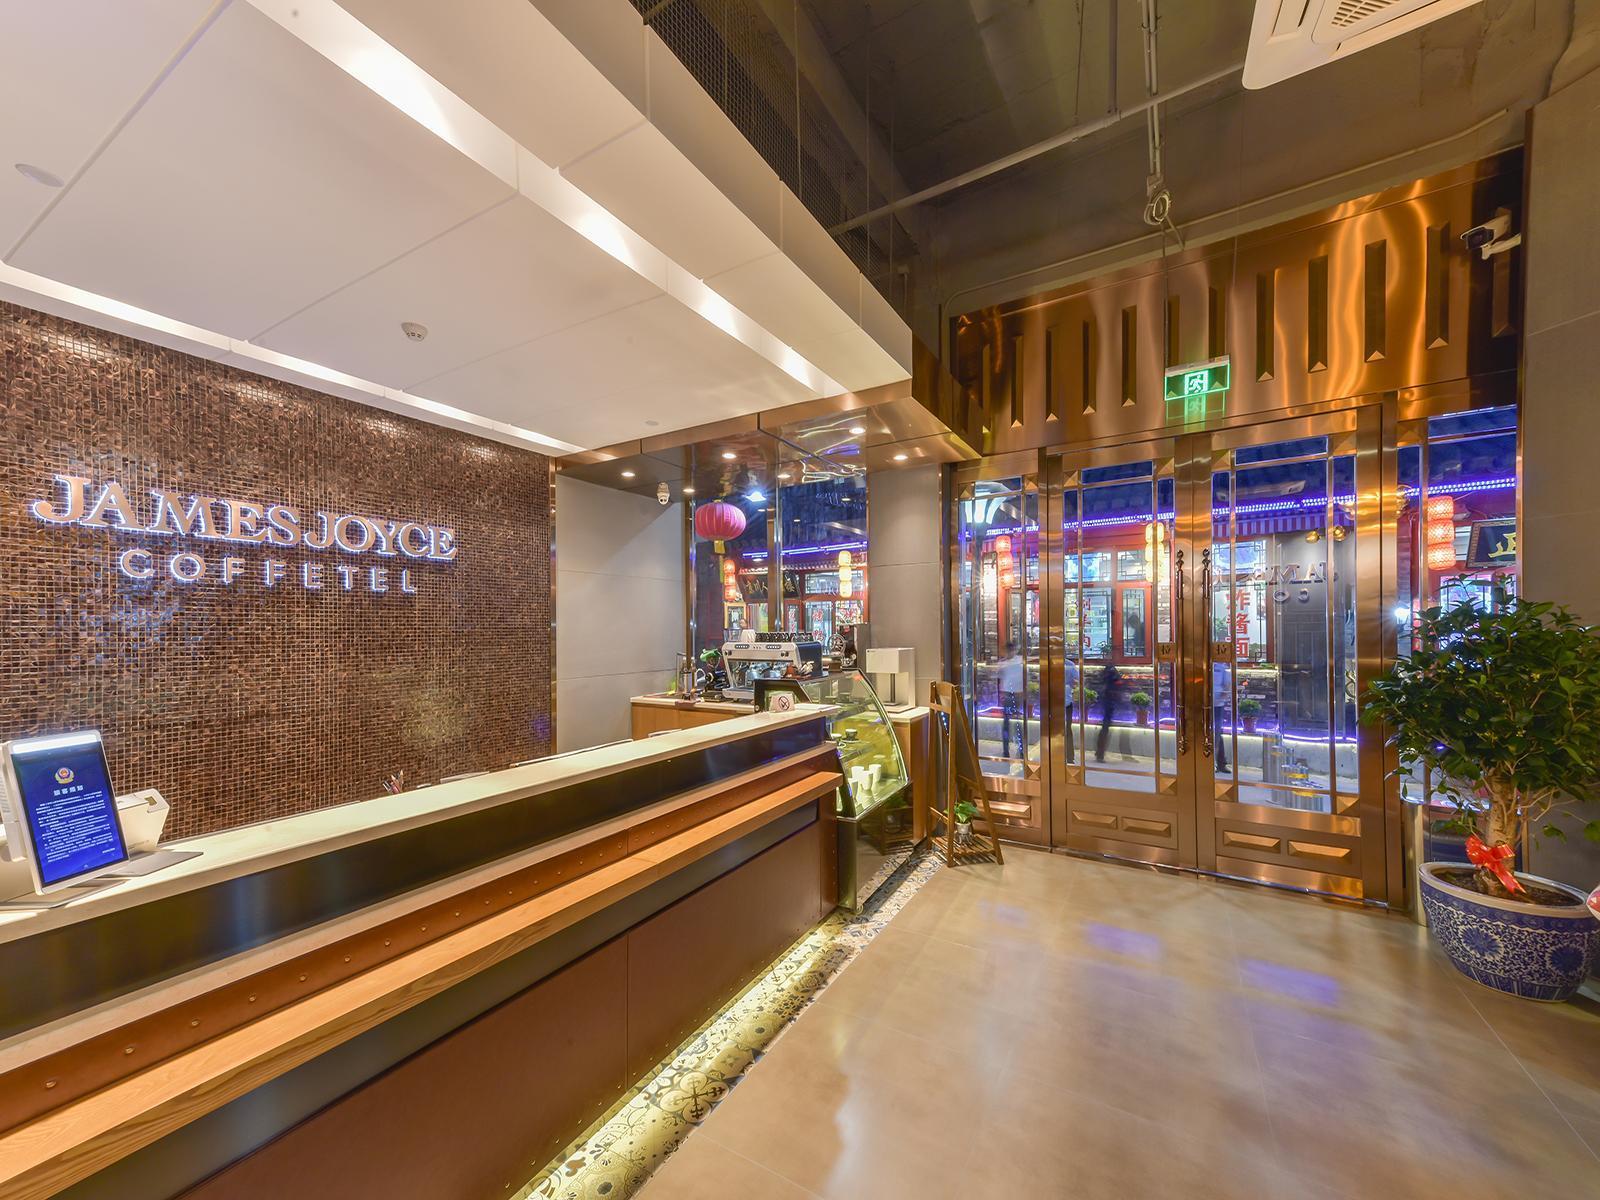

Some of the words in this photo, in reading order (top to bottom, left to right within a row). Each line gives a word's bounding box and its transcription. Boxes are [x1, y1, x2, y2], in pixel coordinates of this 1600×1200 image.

[33, 474, 302, 546] JAMES
[303, 511, 458, 560] JOYCE
[120, 548, 417, 593] COFFETEL
